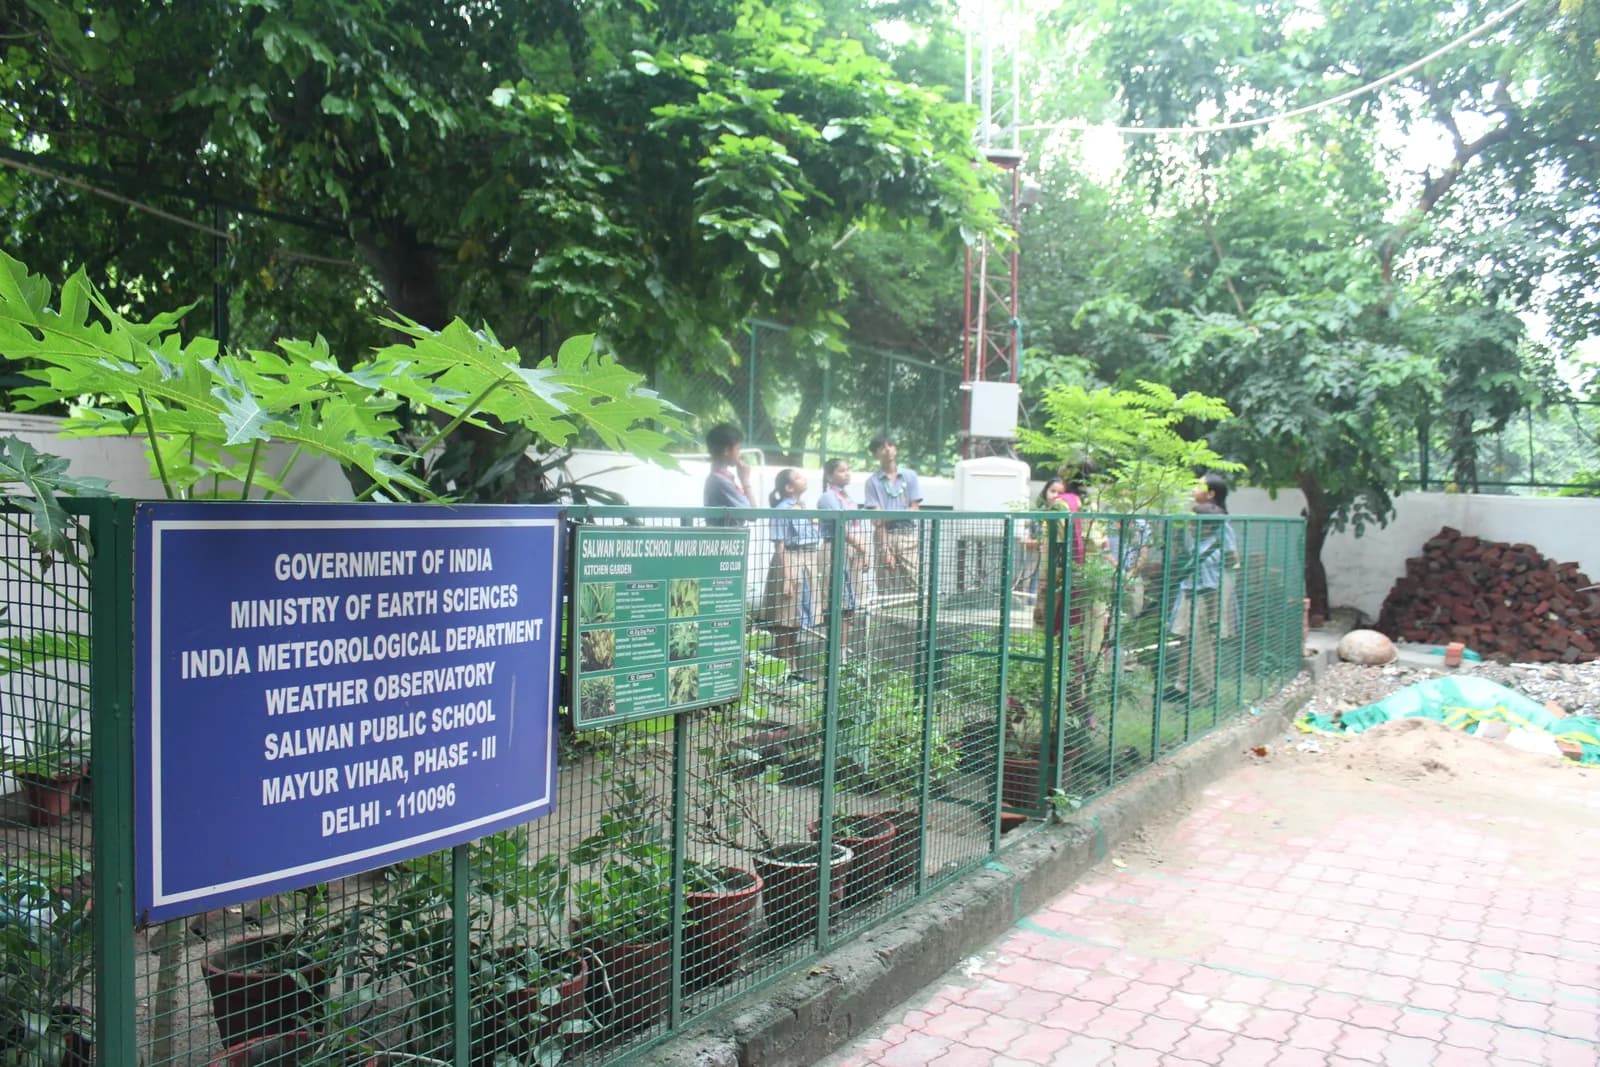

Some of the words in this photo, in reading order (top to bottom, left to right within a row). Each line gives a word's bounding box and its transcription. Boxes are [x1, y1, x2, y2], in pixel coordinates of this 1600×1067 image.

[275, 551, 416, 580] GOVERNMENT
[422, 550, 444, 574] OF
[450, 548, 492, 572] INDIA
[583, 540, 614, 558] SALWAN
[617, 540, 643, 557] PUBLIC
[645, 540, 672, 557] SCHOOL
[674, 540, 697, 556] MAYUR
[699, 540, 719, 556] VIHAR
[721, 540, 739, 556] PHASE
[584, 564, 608, 575] KITCHEN
[609, 564, 632, 574] GARDEN
[720, 562, 729, 571] ECO
[232, 596, 339, 628] MINISTRY
[346, 594, 371, 620] OF
[378, 590, 437, 618] EARTH
[443, 584, 518, 613] SCIENCES
[182, 648, 250, 679] INDIA
[258, 630, 440, 674] METEOROLOGICAL
[446, 618, 543, 652] DEPARTMENT
[266, 679, 368, 715] WEATHER
[374, 661, 496, 704] OBSERVATORY
[265, 722, 353, 760] SALWAN
[360, 711, 426, 745] PUBLIC
[432, 699, 496, 732] SCHOOL
[263, 768, 339, 805] MAYUR
[344, 755, 408, 789] VIHAR,
[414, 741, 468, 775] PHASE
[482, 736, 496, 760] III
[322, 800, 379, 836] DELHI
[397, 783, 455, 818] 110096
